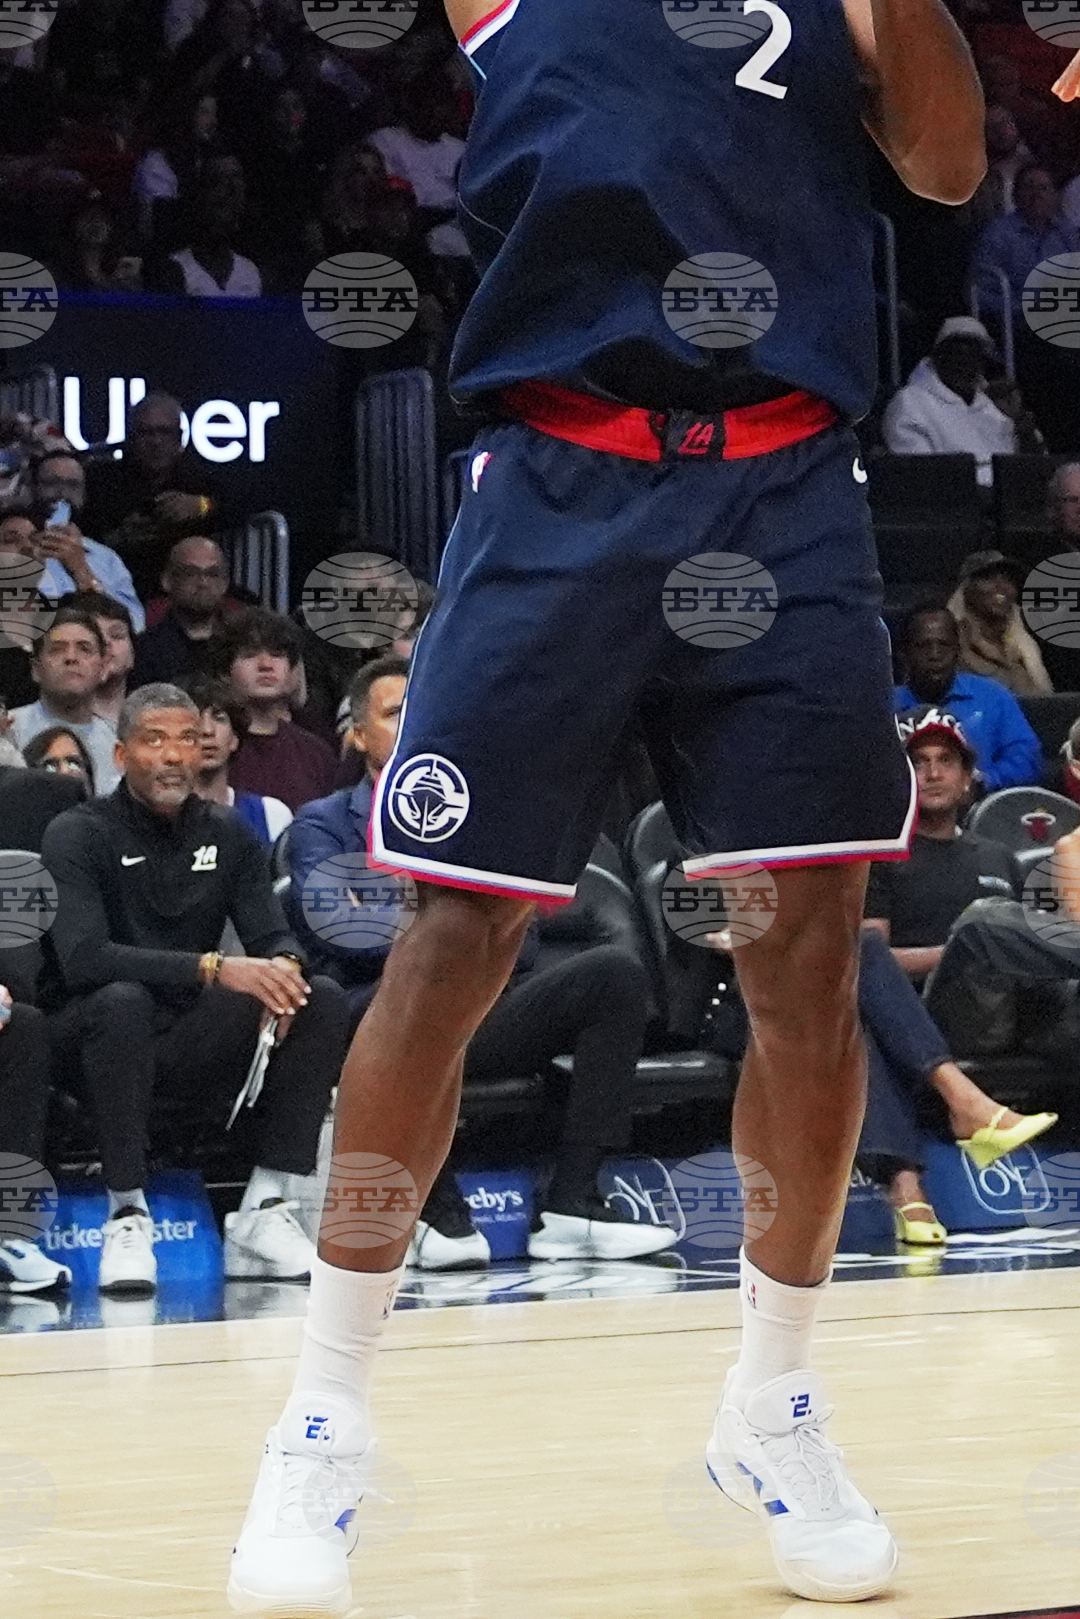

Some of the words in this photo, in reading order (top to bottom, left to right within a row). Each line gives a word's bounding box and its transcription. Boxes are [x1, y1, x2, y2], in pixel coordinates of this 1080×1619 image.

[735, 0, 792, 100] 2
[64, 376, 280, 463] Uer
[45, 1218, 197, 1251] tickester
